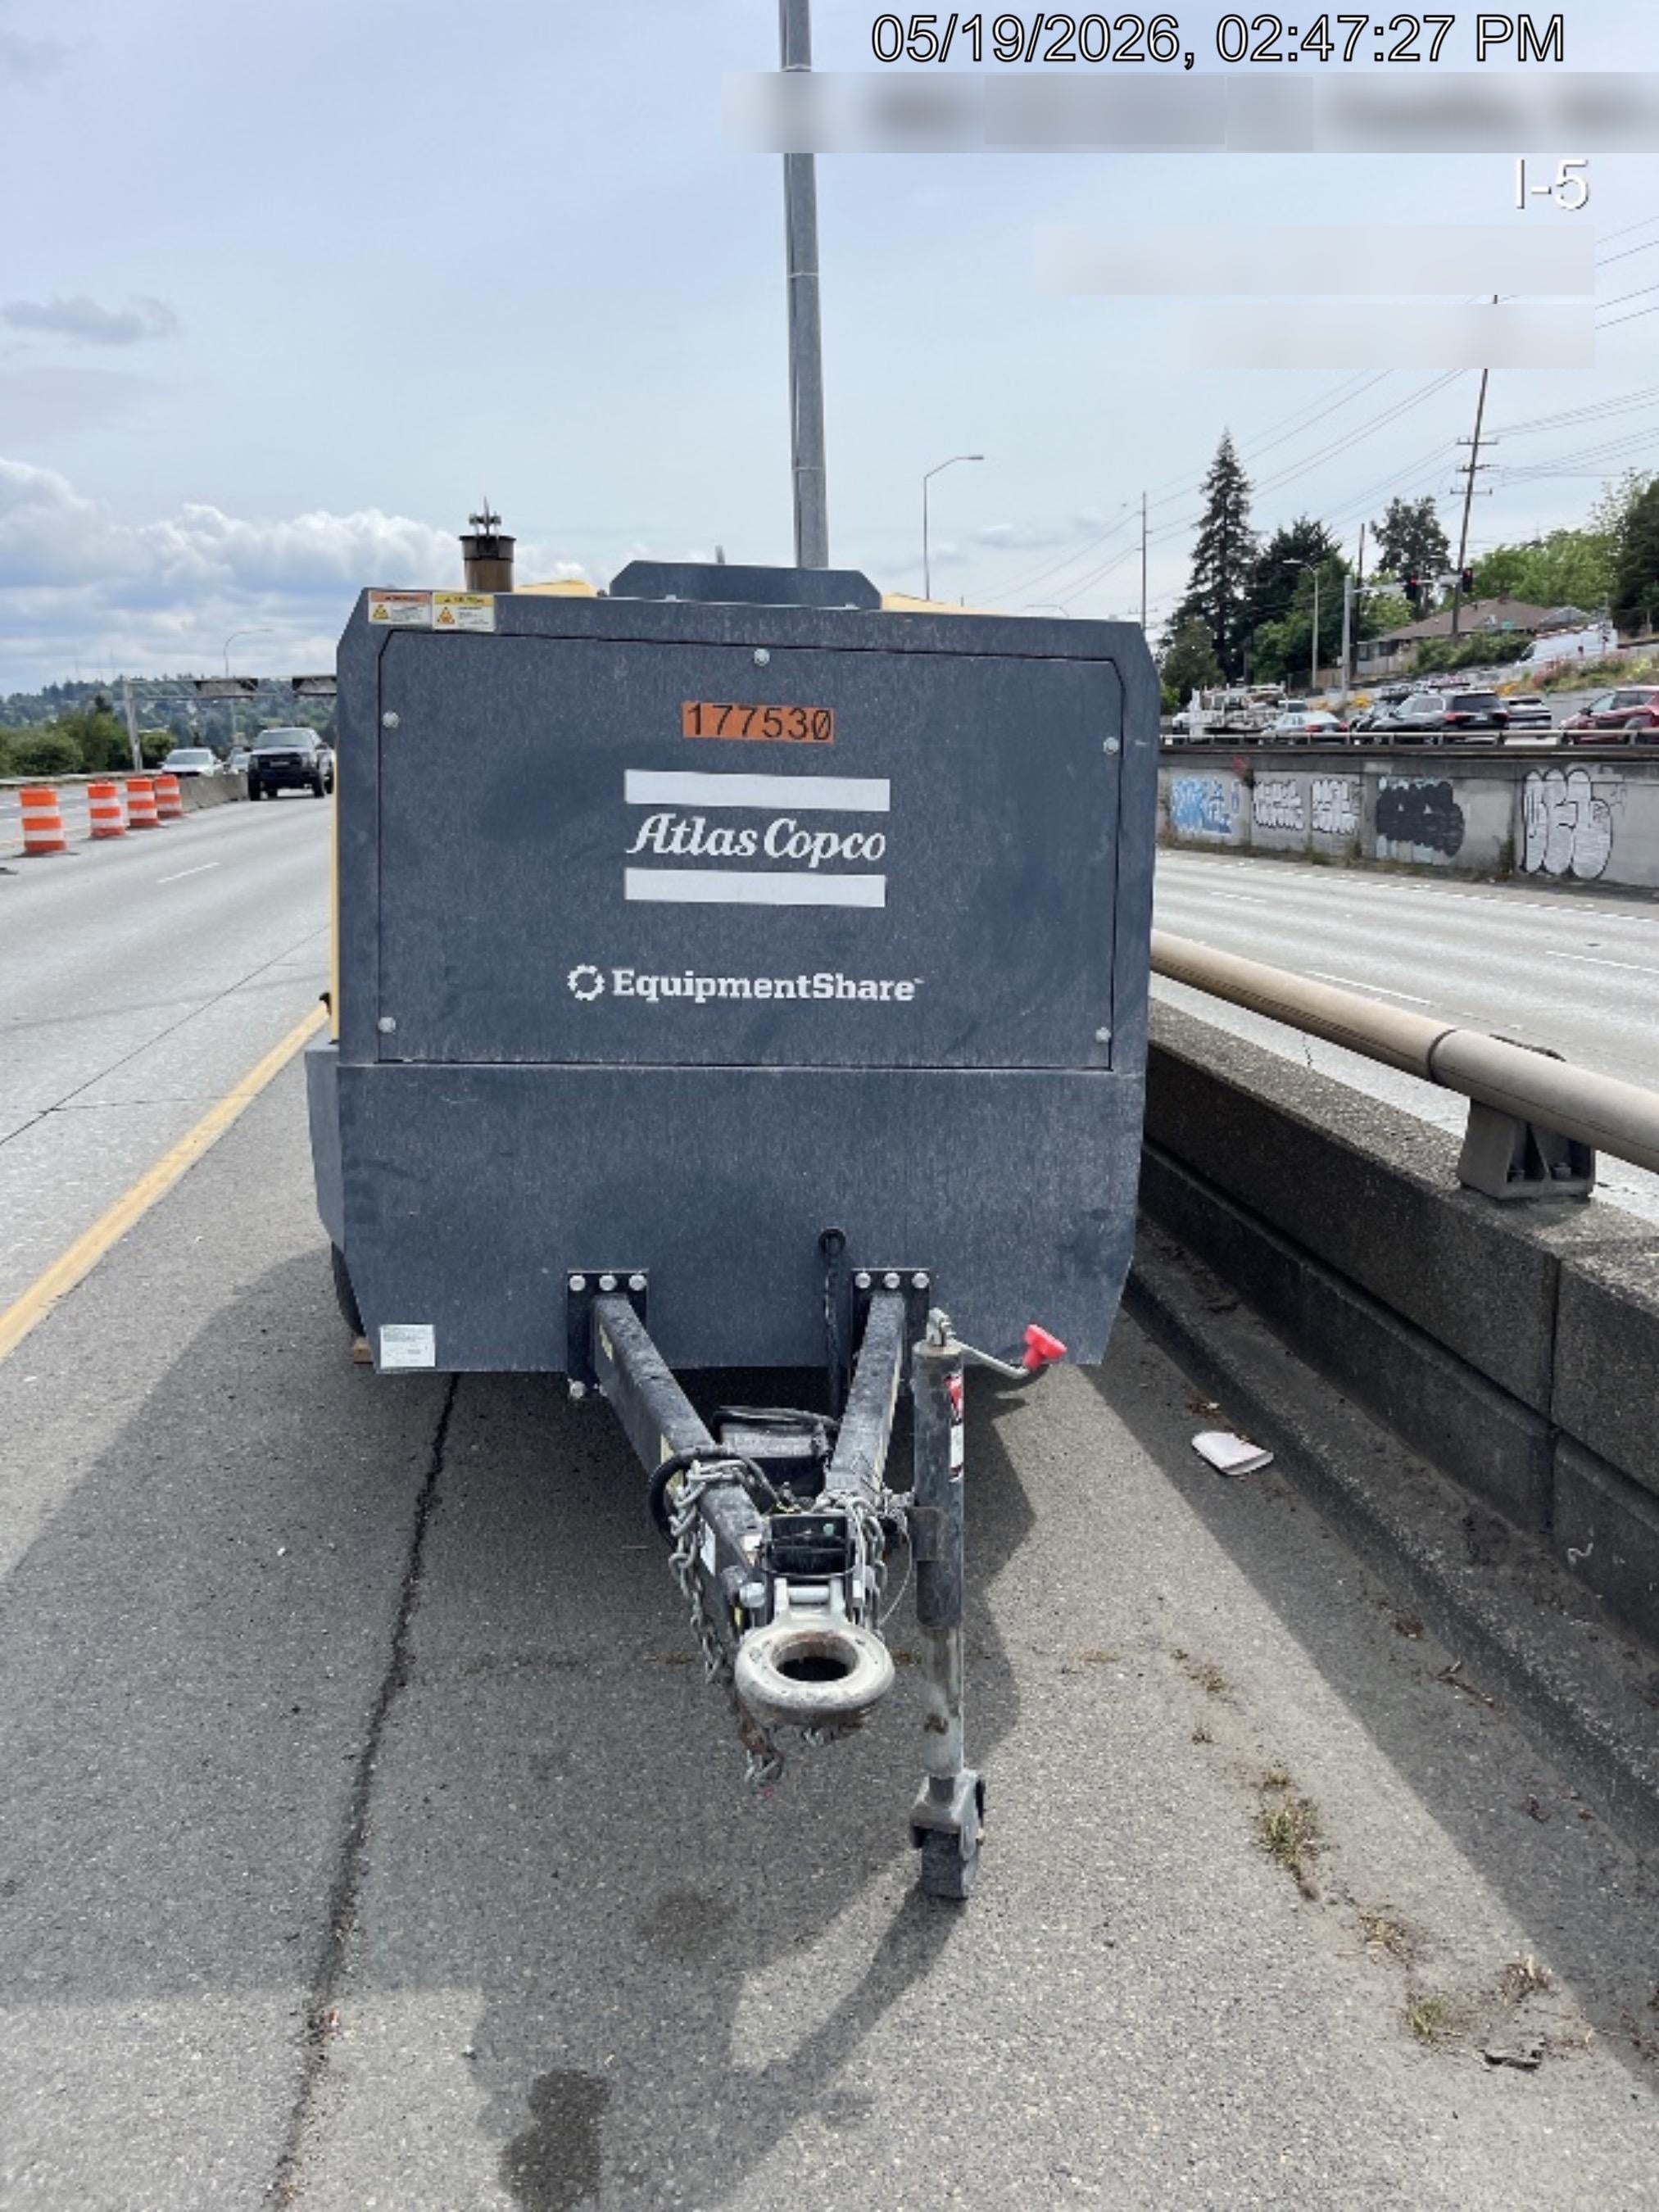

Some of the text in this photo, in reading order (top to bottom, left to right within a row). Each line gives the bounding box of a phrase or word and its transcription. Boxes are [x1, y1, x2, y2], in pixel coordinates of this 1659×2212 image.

[687, 702, 832, 741] 177530
[625, 813, 886, 868] Atlas Copco
[611, 968, 916, 1004] EquipmentShare
